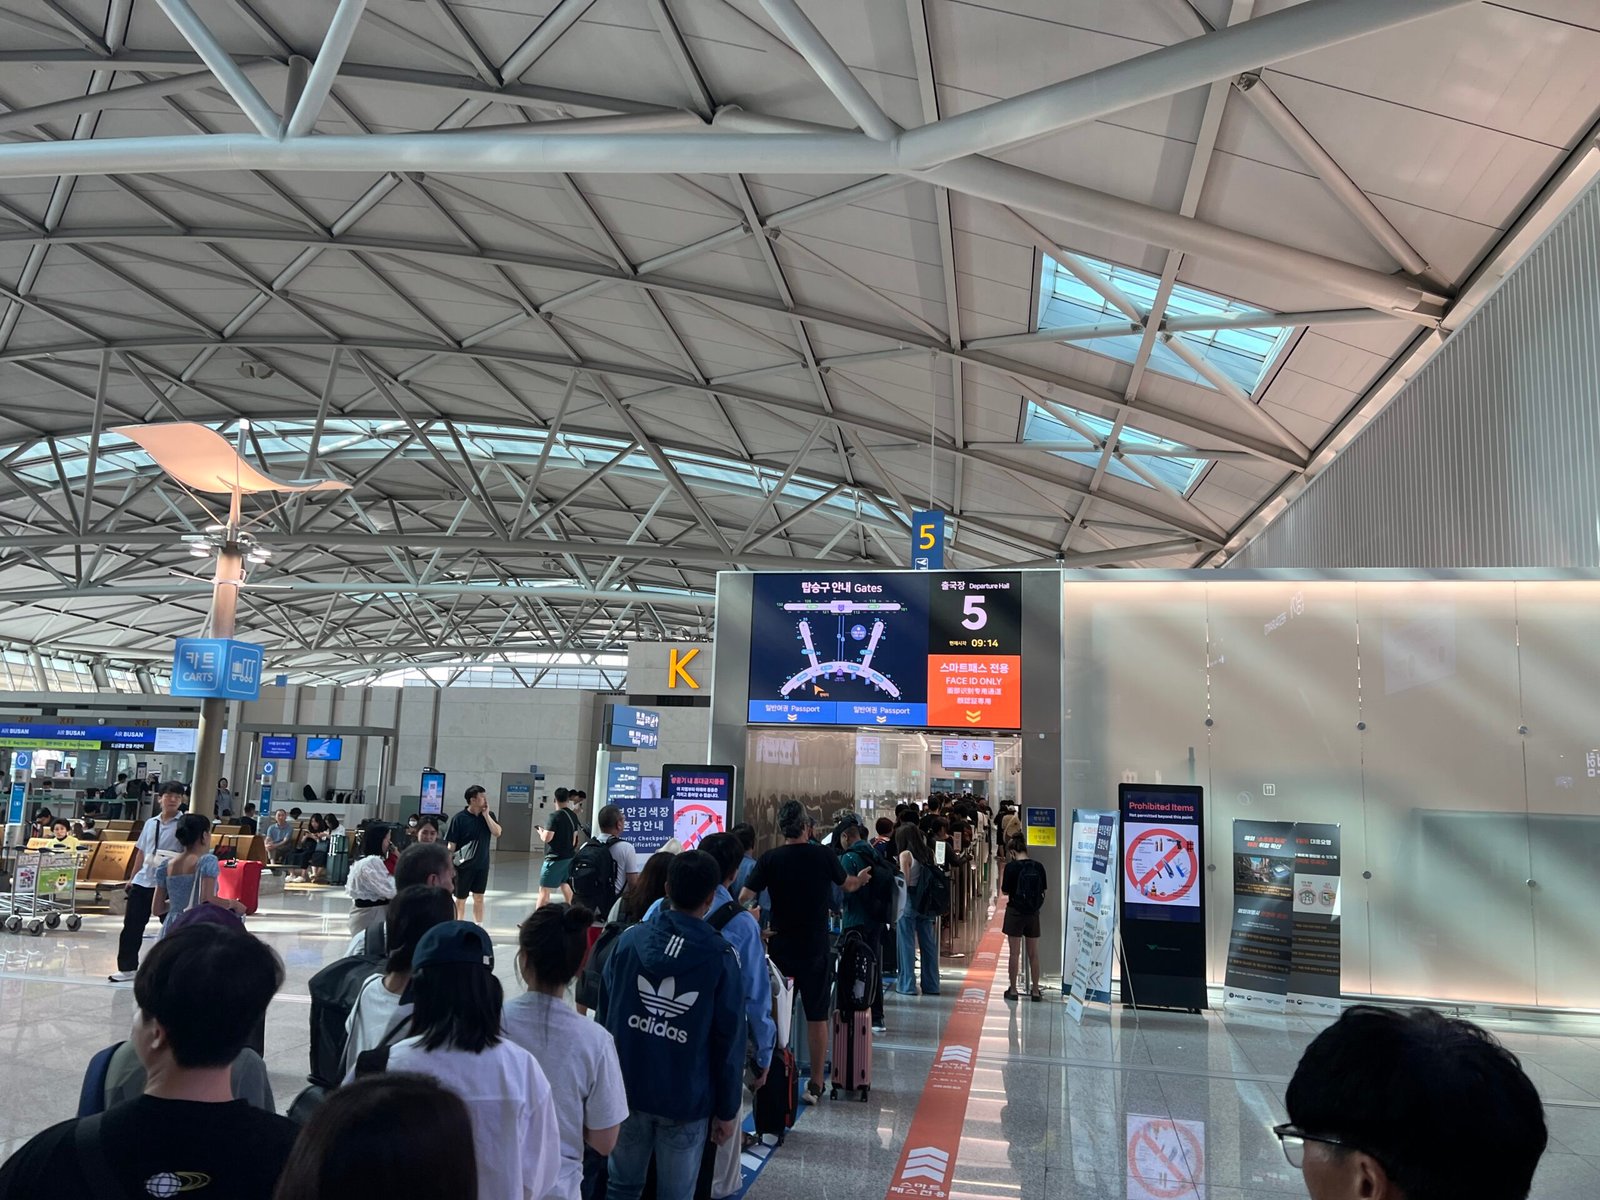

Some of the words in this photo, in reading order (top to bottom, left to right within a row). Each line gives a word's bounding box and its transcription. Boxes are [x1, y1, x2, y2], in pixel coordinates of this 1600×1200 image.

[919, 524, 936, 550] 5
[802, 582, 830, 594] 탑승구
[832, 582, 851, 594] 안내
[854, 583, 882, 593] Gates
[941, 581, 965, 591] 출국장
[969, 582, 998, 590] Departure
[961, 595, 988, 630] 5
[971, 639, 999, 648] 09:14
[186, 652, 215, 670] 카트
[668, 648, 701, 689] K
[940, 663, 988, 674] 스마트패스
[990, 663, 1009, 674] 전용
[182, 672, 214, 682] CARTS
[766, 704, 788, 712] 일반여권
[1129, 802, 1170, 811] Prohibited
[1172, 803, 1194, 812] Items
[628, 1014, 688, 1044] adidas
